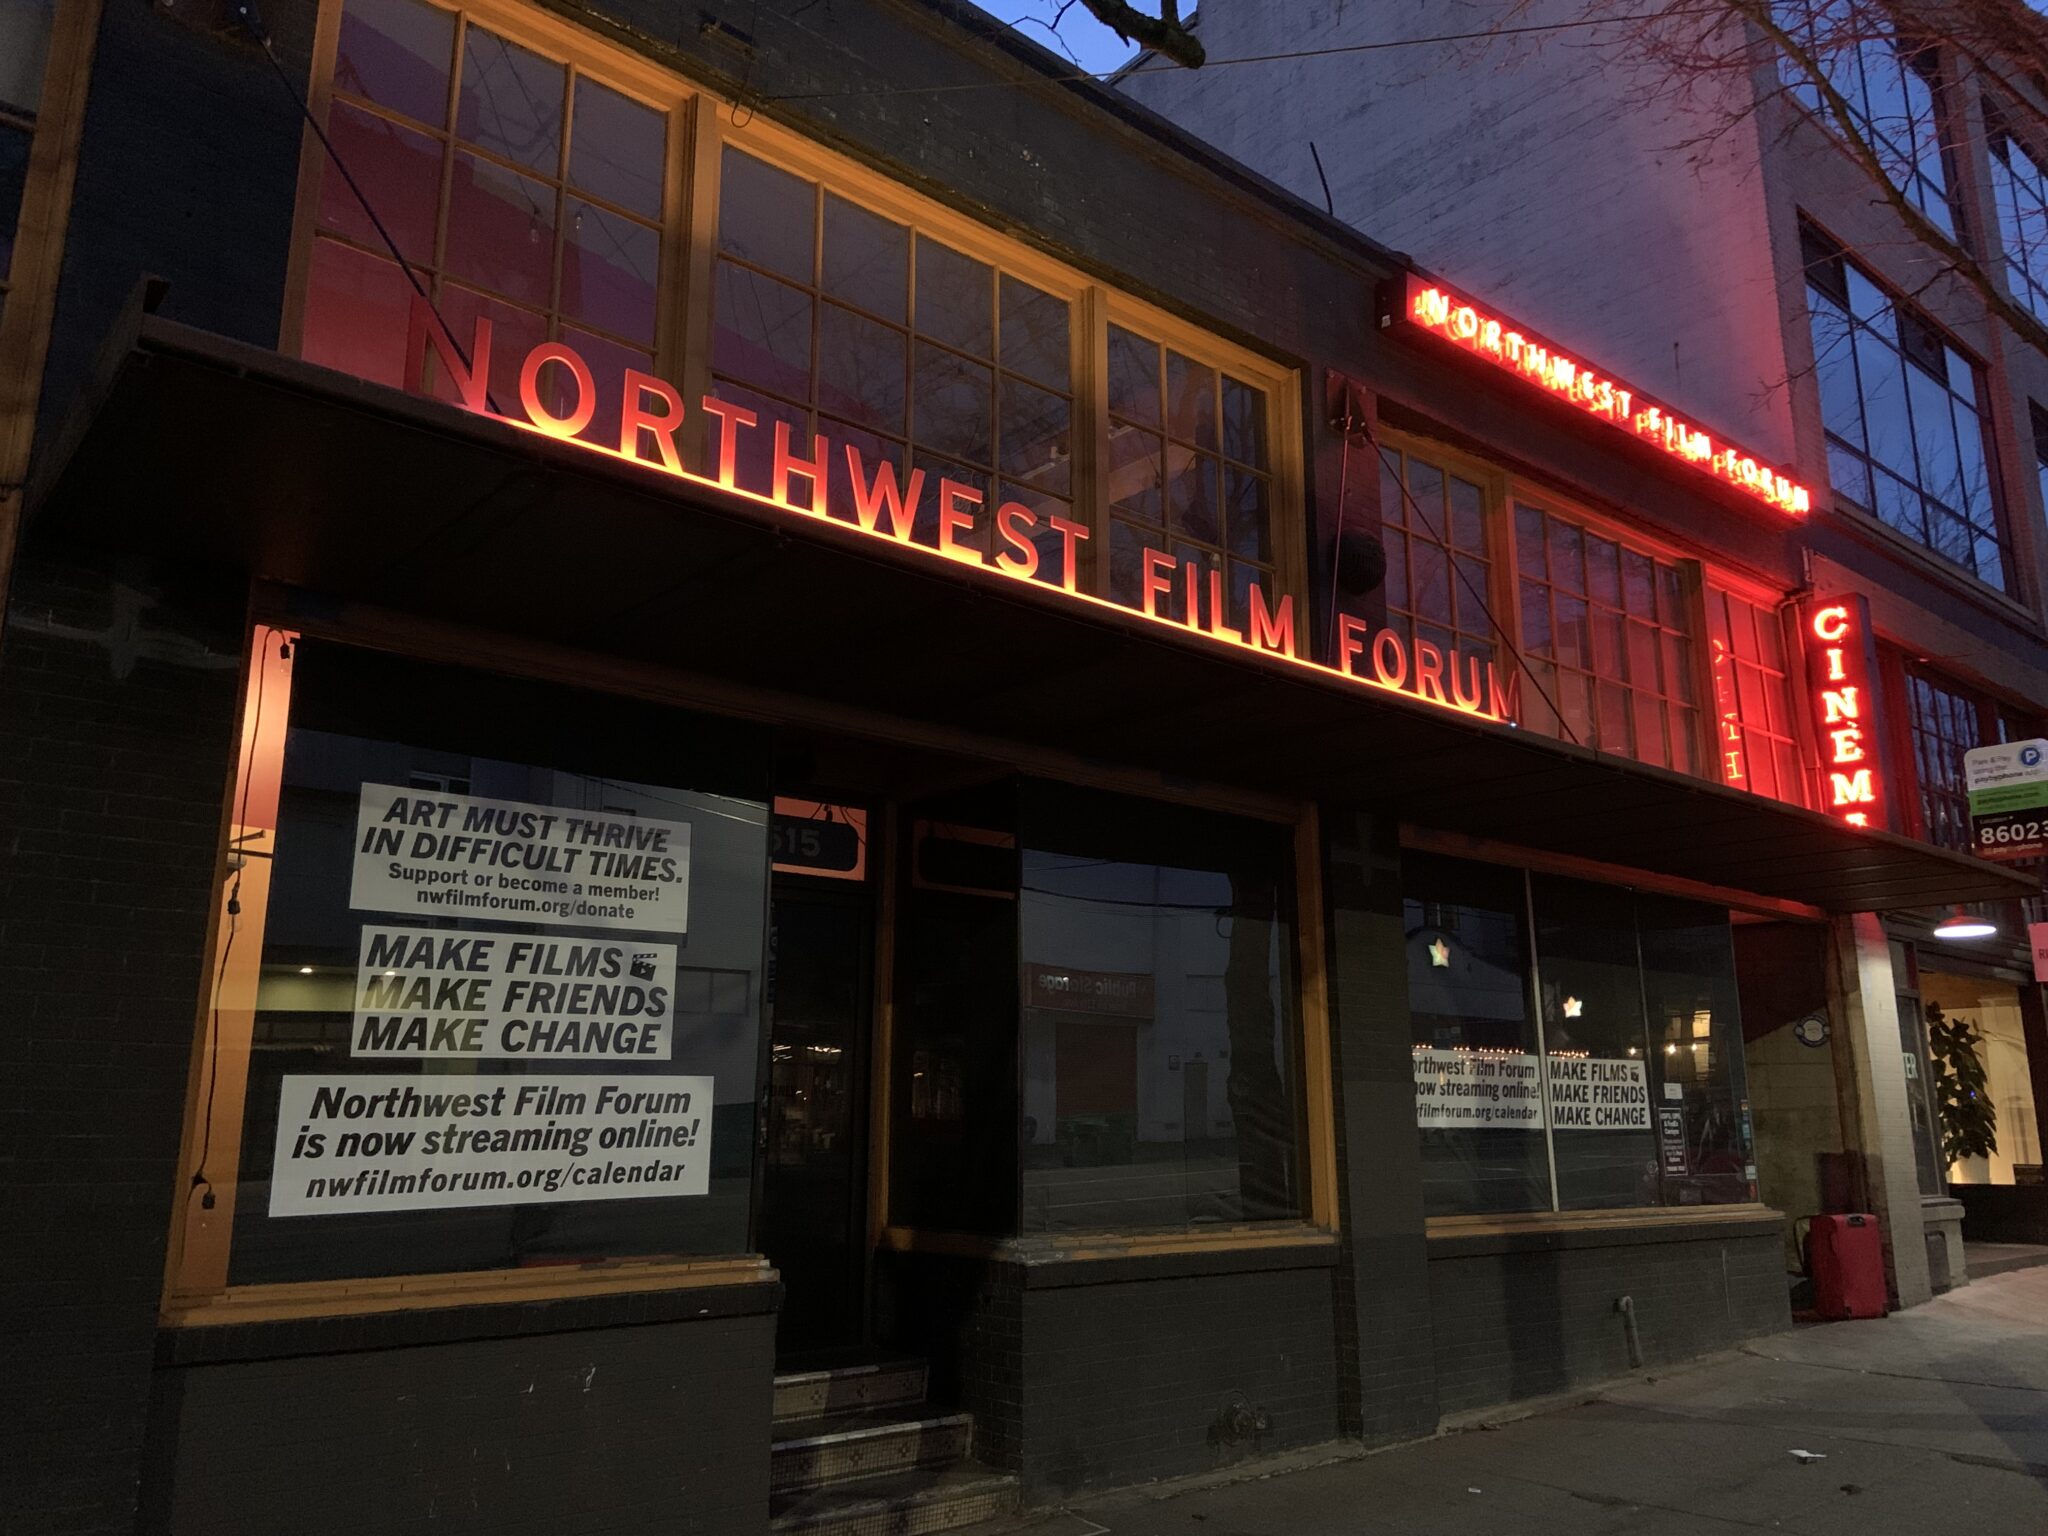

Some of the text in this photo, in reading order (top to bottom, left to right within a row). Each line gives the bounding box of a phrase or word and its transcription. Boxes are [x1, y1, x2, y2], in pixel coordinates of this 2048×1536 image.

[1418, 289, 1810, 513] NORTHWEST FILM FORUM
[403, 293, 1522, 726] NORTHWEST FILM FORUM
[383, 796, 671, 854] ART MUST THRIVE
[360, 826, 685, 884] IN DIFFICULT TIMES.
[388, 862, 660, 903] Support or become a member!
[416, 886, 635, 921] nwfilmforum.org/donate
[365, 933, 624, 979] MAKE FILMS
[361, 974, 669, 1018] MAKE FRIENDS
[358, 1016, 661, 1055] MAKE CHANGE
[1439, 1078, 1500, 1101] streaming
[1502, 1081, 1541, 1100] online!
[1499, 1060, 1535, 1079] Forum
[1550, 1061, 1628, 1082] MAKE FILMS
[309, 1084, 692, 1121] Northwest Film Forum
[1552, 1083, 1589, 1103] MAKE
[1592, 1084, 1646, 1104] FRIENDS
[1554, 1105, 1646, 1126] MAKE CHANGE
[291, 1117, 700, 1159] is now streaming online!
[306, 1160, 685, 1200] nwfilmforum.org/calendar
